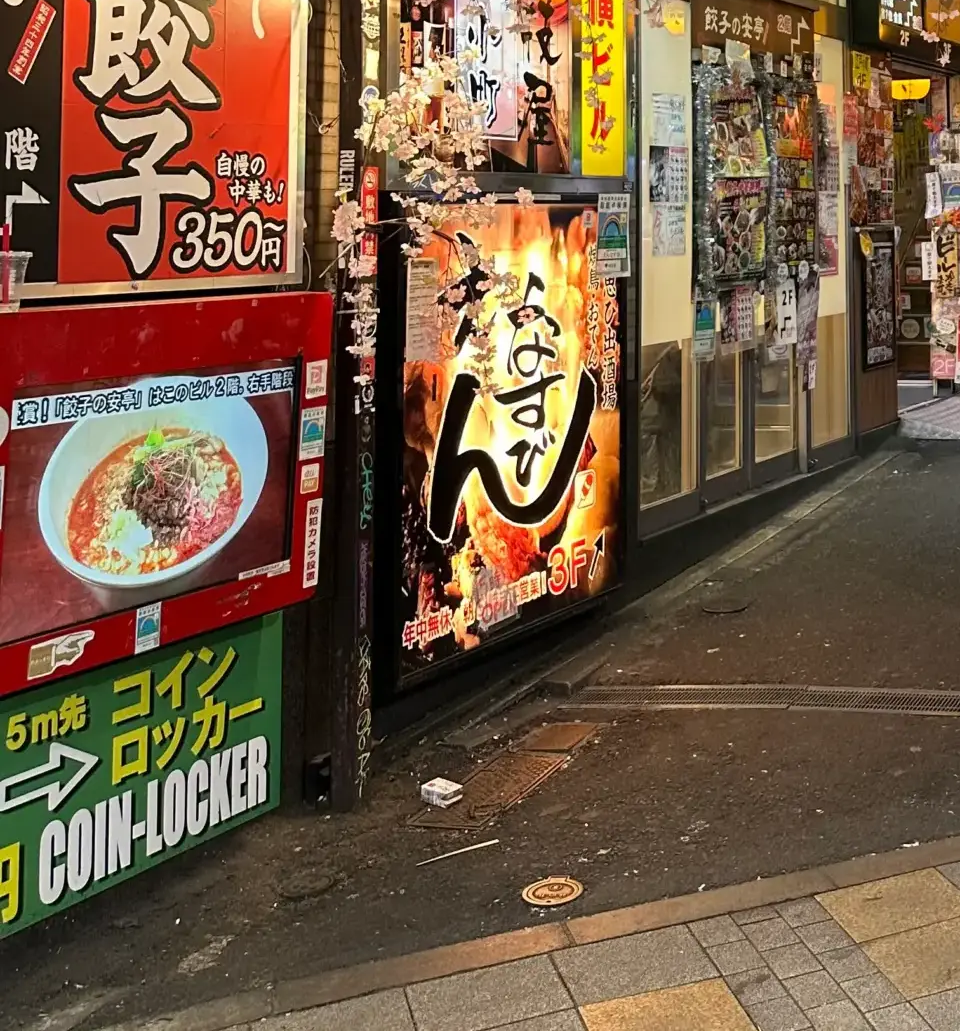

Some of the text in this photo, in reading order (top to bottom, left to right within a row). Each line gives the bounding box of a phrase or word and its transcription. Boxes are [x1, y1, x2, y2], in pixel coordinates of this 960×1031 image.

[704, 5, 765, 41] 餃子の安亭
[900, 29, 910, 47] 2F
[217, 152, 265, 178] 自慢の
[229, 179, 285, 205] 中華も！
[781, 289, 793, 306] 2F
[306, 505, 319, 582] 防犯カメラ設置
[547, 539, 586, 596] 3F
[402, 605, 453, 651] 年中無休
[111, 646, 238, 725] コイン
[6, 693, 87, 750] 5m先
[111, 694, 264, 788] ロッカー
[38, 734, 269, 905] COIN-LOCKER
